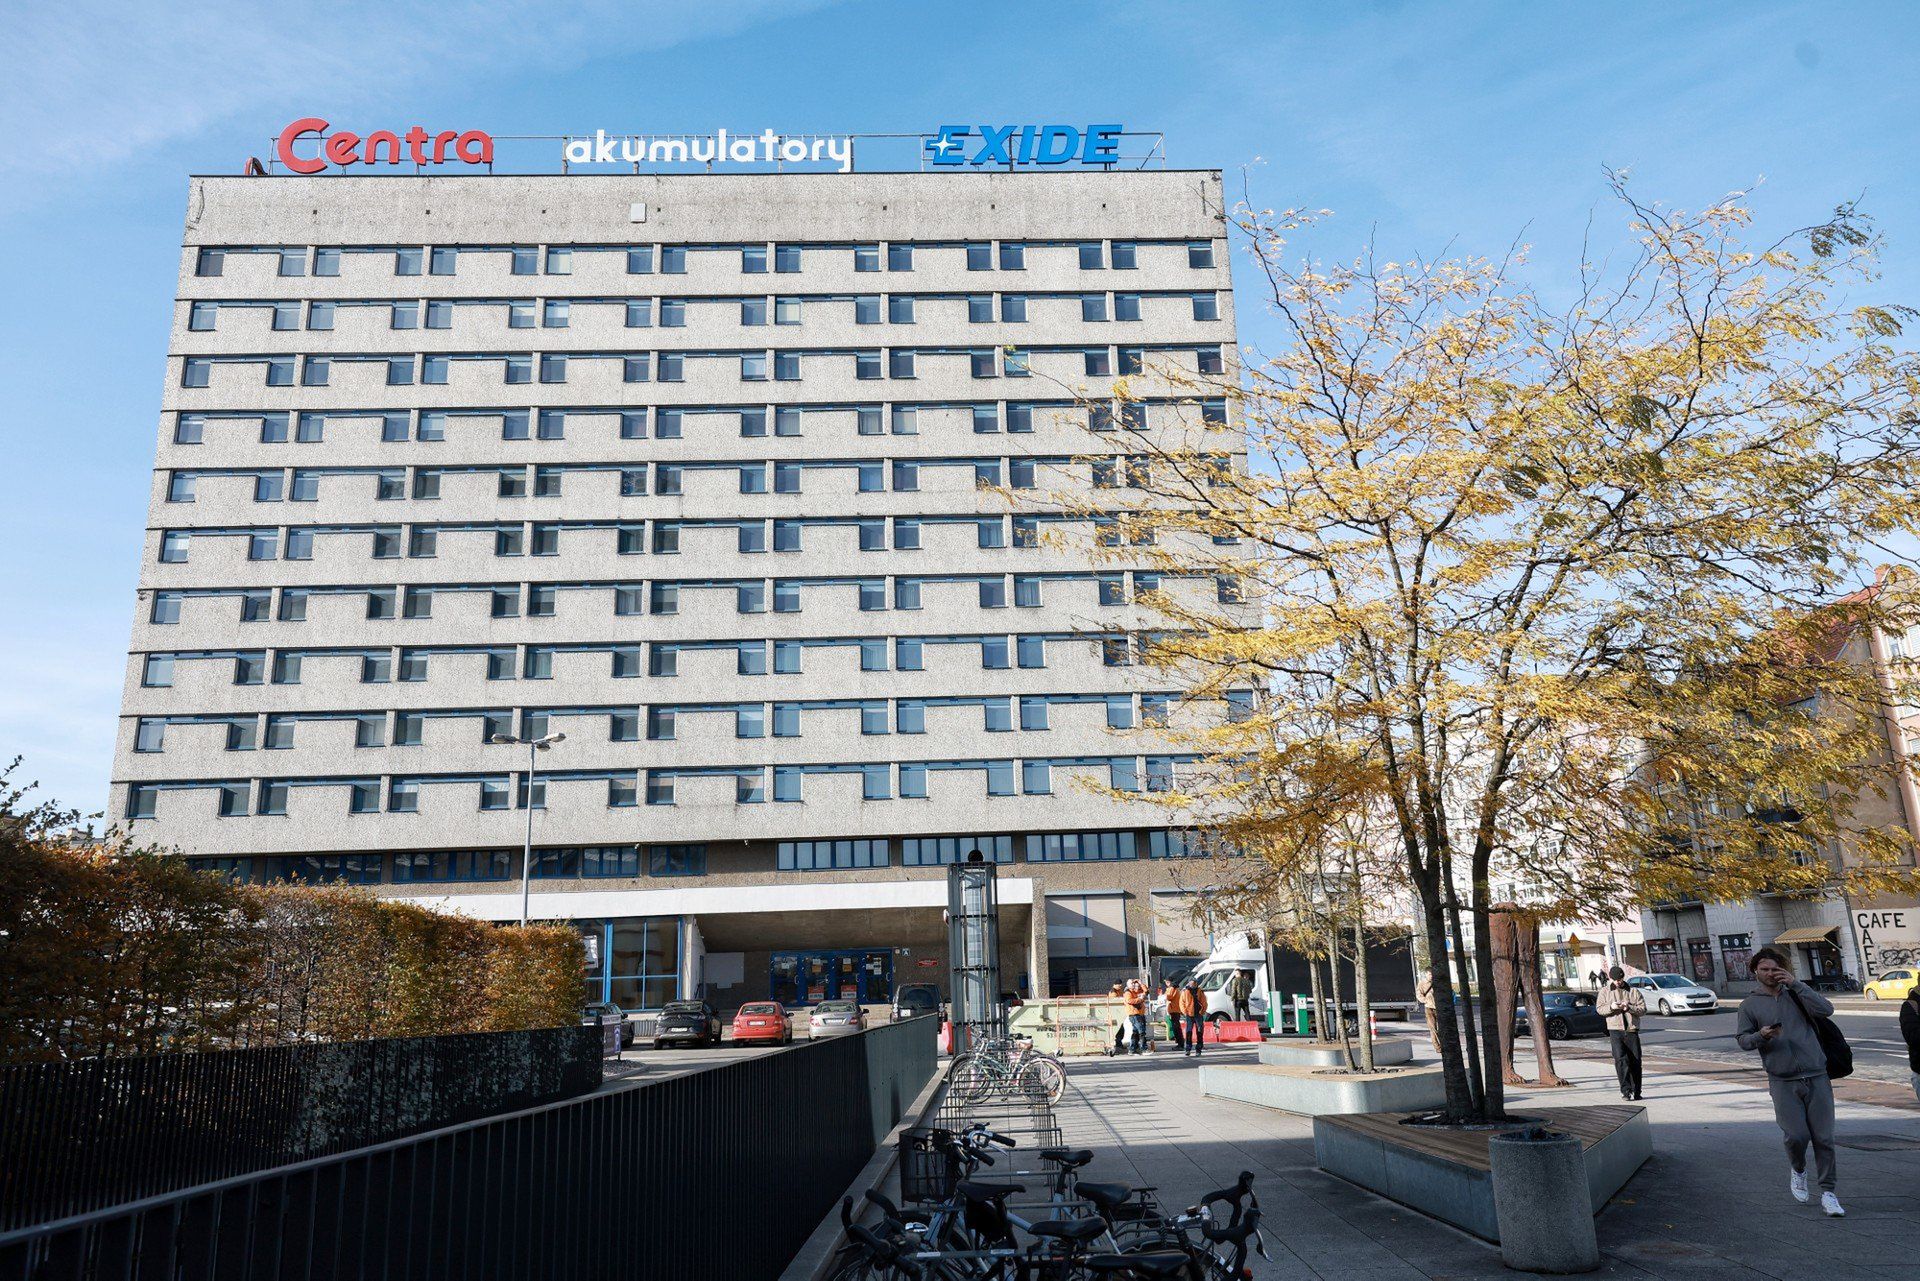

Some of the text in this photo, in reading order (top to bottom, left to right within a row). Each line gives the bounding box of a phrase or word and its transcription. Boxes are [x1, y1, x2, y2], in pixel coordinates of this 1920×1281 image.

[277, 117, 1123, 174] Centra akumulatory EXIDE
[1857, 912, 1906, 929] CAFE
